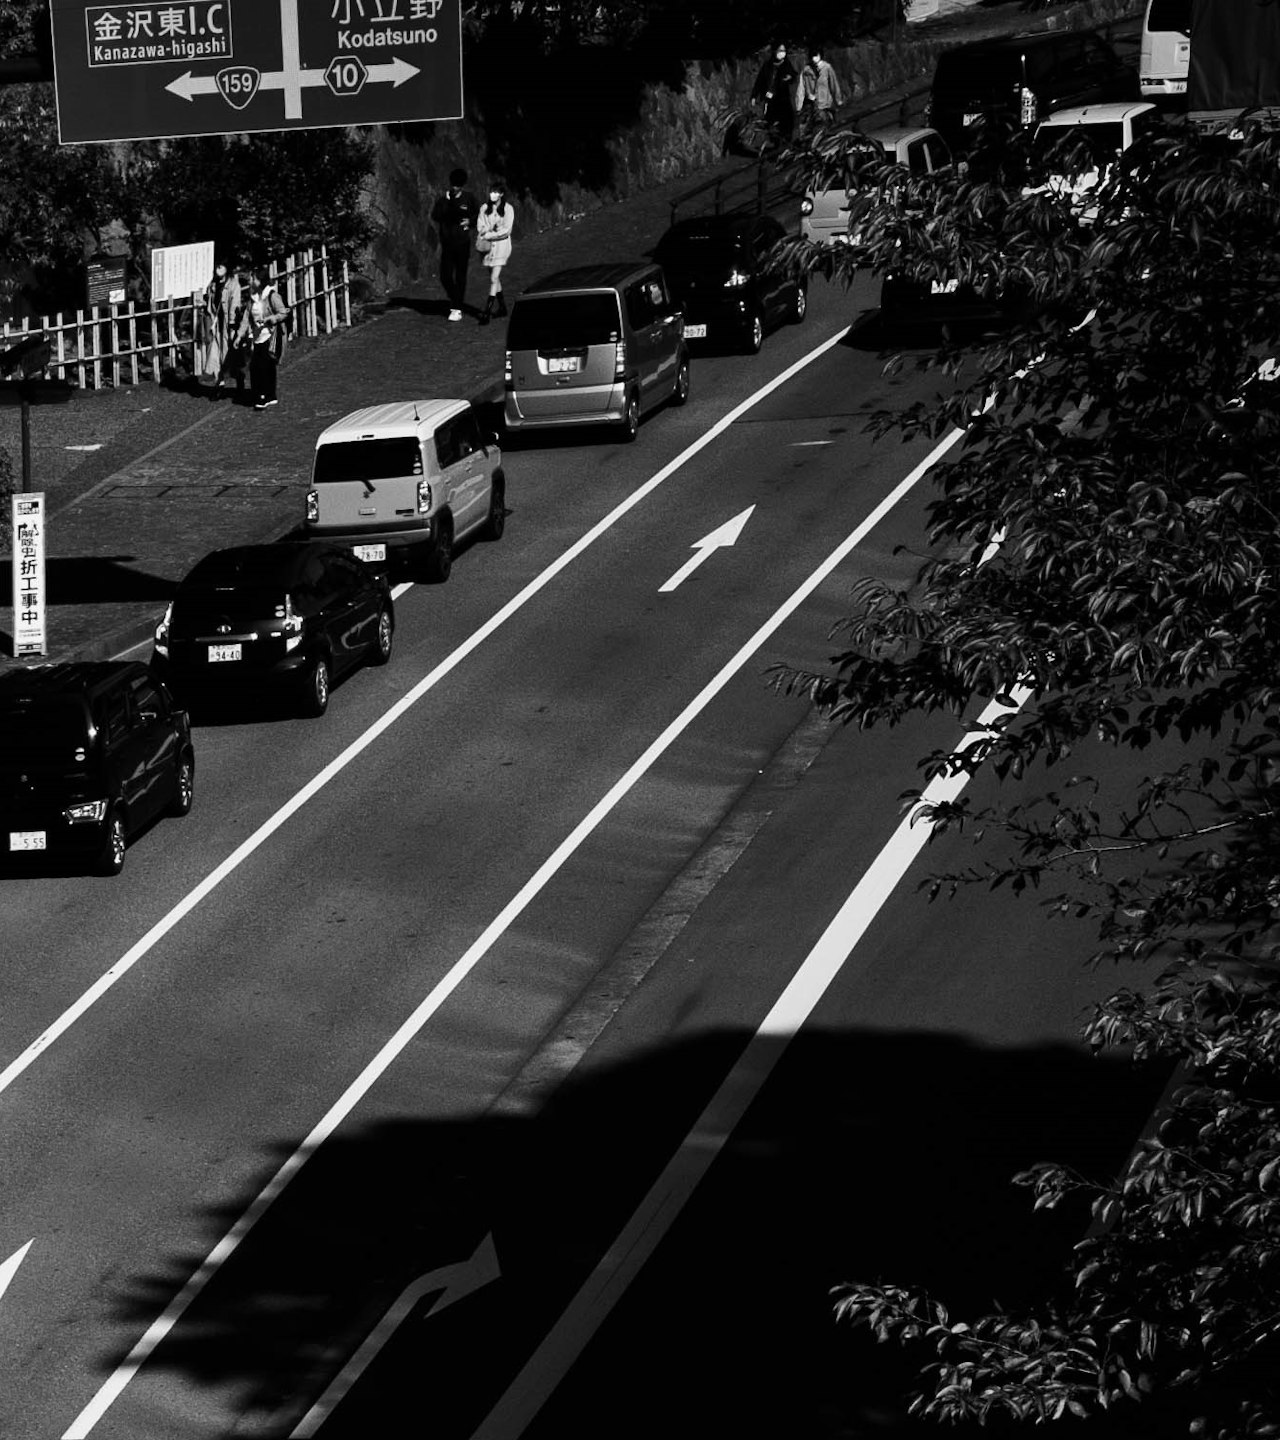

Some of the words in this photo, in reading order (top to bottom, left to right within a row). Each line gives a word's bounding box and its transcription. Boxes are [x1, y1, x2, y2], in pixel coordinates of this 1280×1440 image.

[94, 36, 227, 61] Kanazawa-higashi
[337, 28, 438, 49] Kodatsuno
[222, 72, 253, 94] 159
[332, 63, 359, 88] 10
